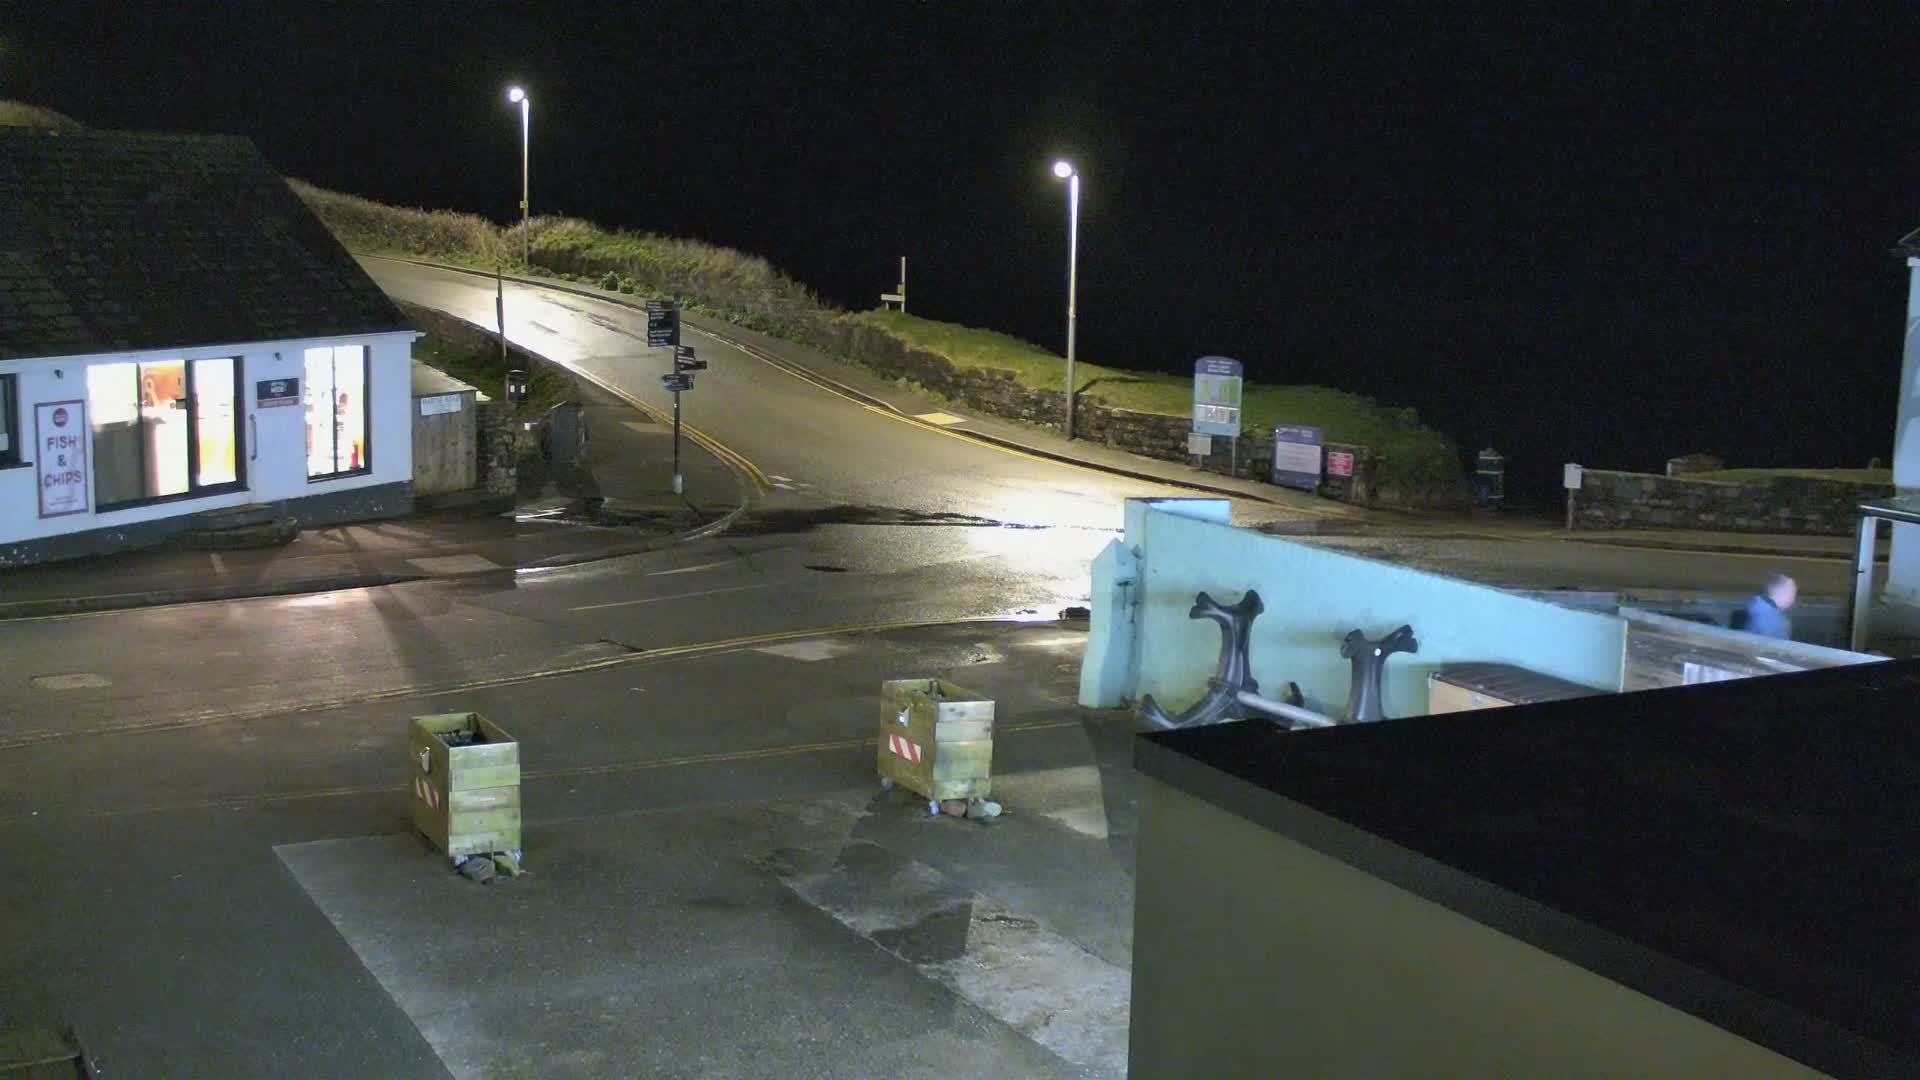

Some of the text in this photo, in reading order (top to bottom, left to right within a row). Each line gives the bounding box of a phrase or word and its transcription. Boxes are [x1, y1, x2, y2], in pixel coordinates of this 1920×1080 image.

[47, 435, 77, 450] FISH
[57, 454, 67, 467] &
[44, 471, 82, 488] CHIPS
